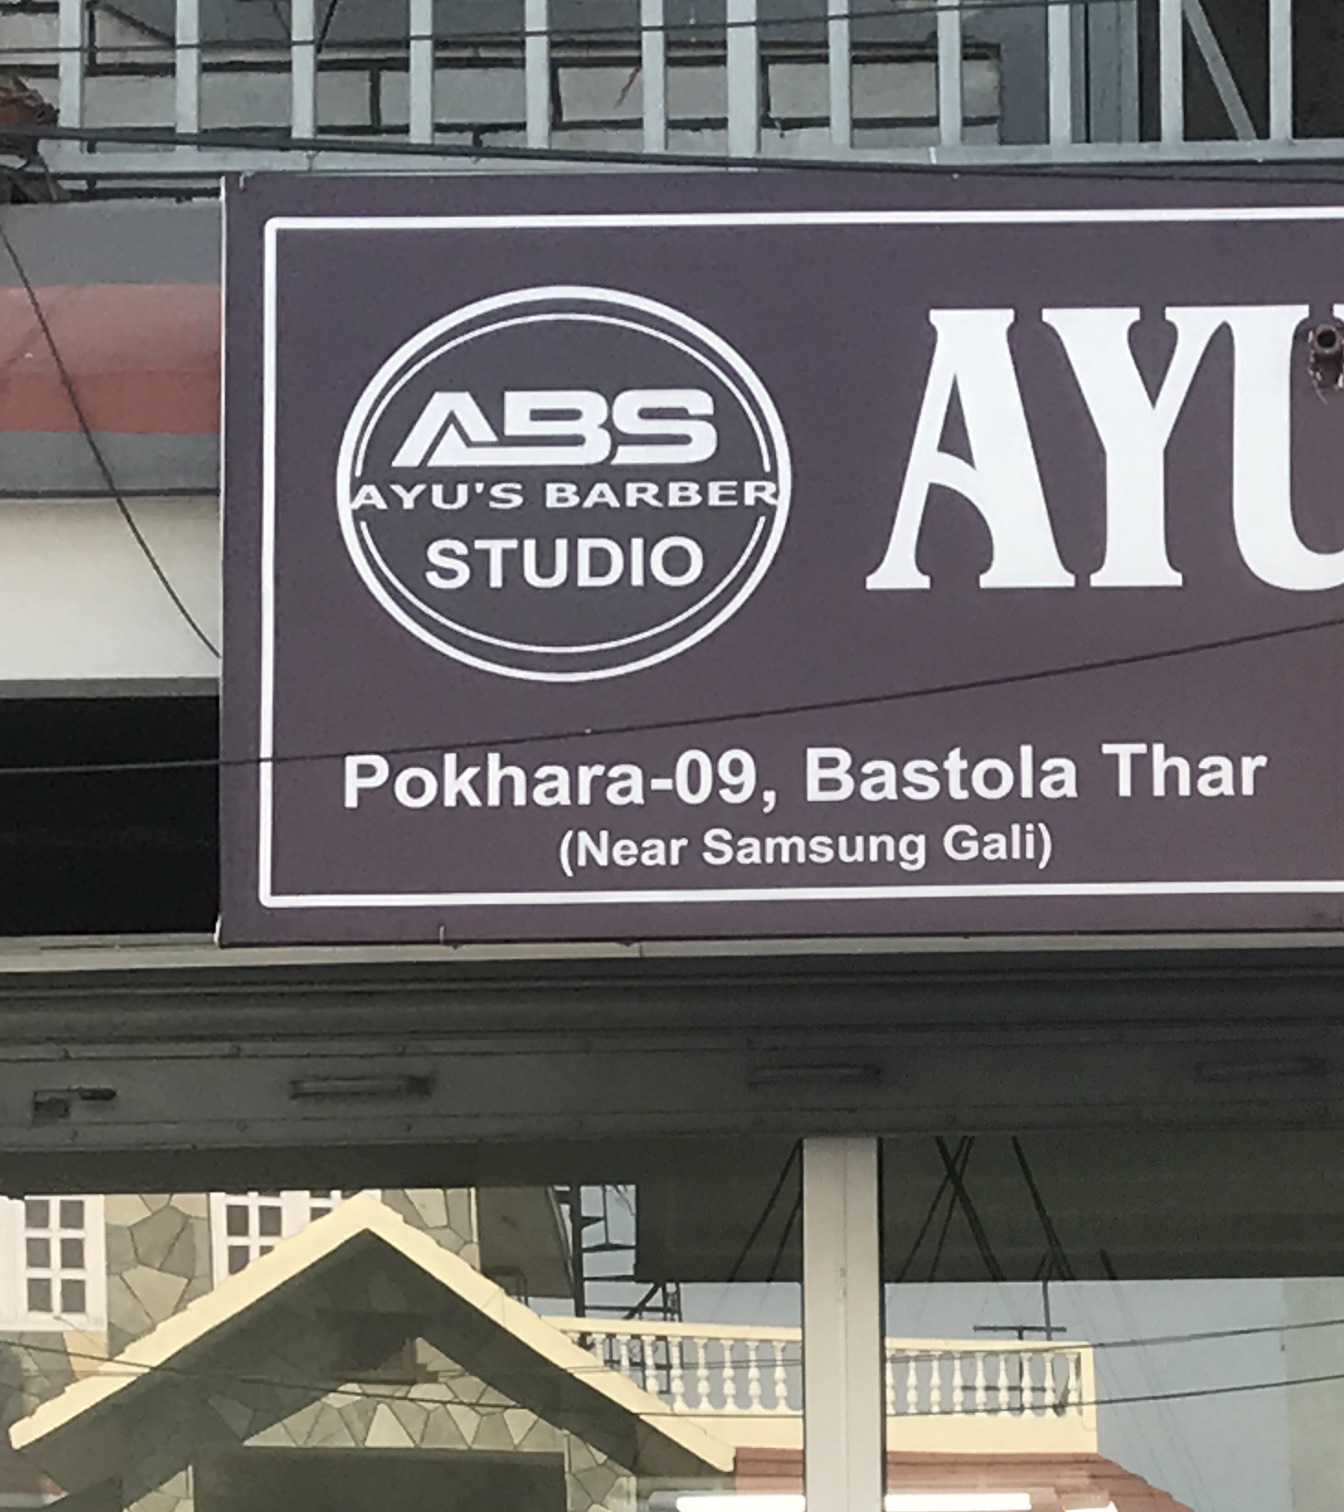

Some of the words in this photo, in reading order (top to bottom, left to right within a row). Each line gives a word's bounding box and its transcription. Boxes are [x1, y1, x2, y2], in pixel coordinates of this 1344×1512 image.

[391, 388, 718, 467] ABS
[350, 482, 524, 510] AYU'S
[545, 481, 778, 508] BARBER
[425, 536, 704, 589] STUDIO
[343, 748, 778, 813] Pokhara-09,
[805, 744, 1079, 803] Bastola
[1100, 743, 1269, 798] Thar
[559, 829, 689, 874] (Near
[701, 827, 927, 872] Samsung
[942, 821, 1053, 870] Gali)
